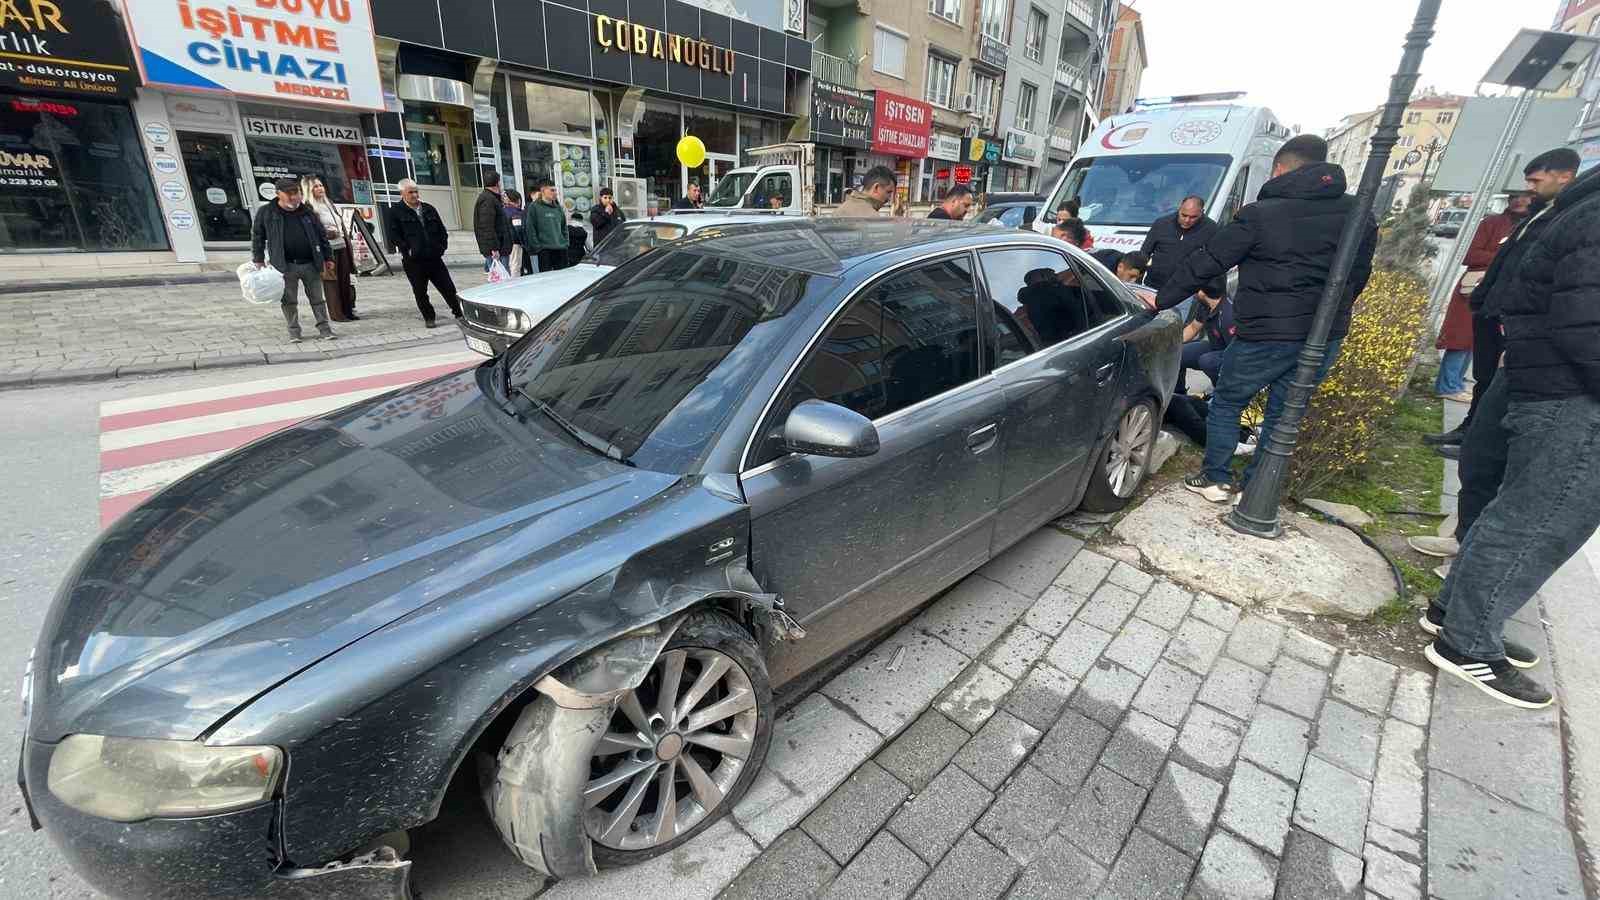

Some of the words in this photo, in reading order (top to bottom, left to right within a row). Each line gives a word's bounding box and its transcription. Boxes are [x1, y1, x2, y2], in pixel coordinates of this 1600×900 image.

[177, 0, 340, 54] İŞİTME
[596, 14, 735, 75] ÇOBANOĞLU
[26, 64, 116, 82] dekorasyon
[187, 38, 348, 85] CİHAZI
